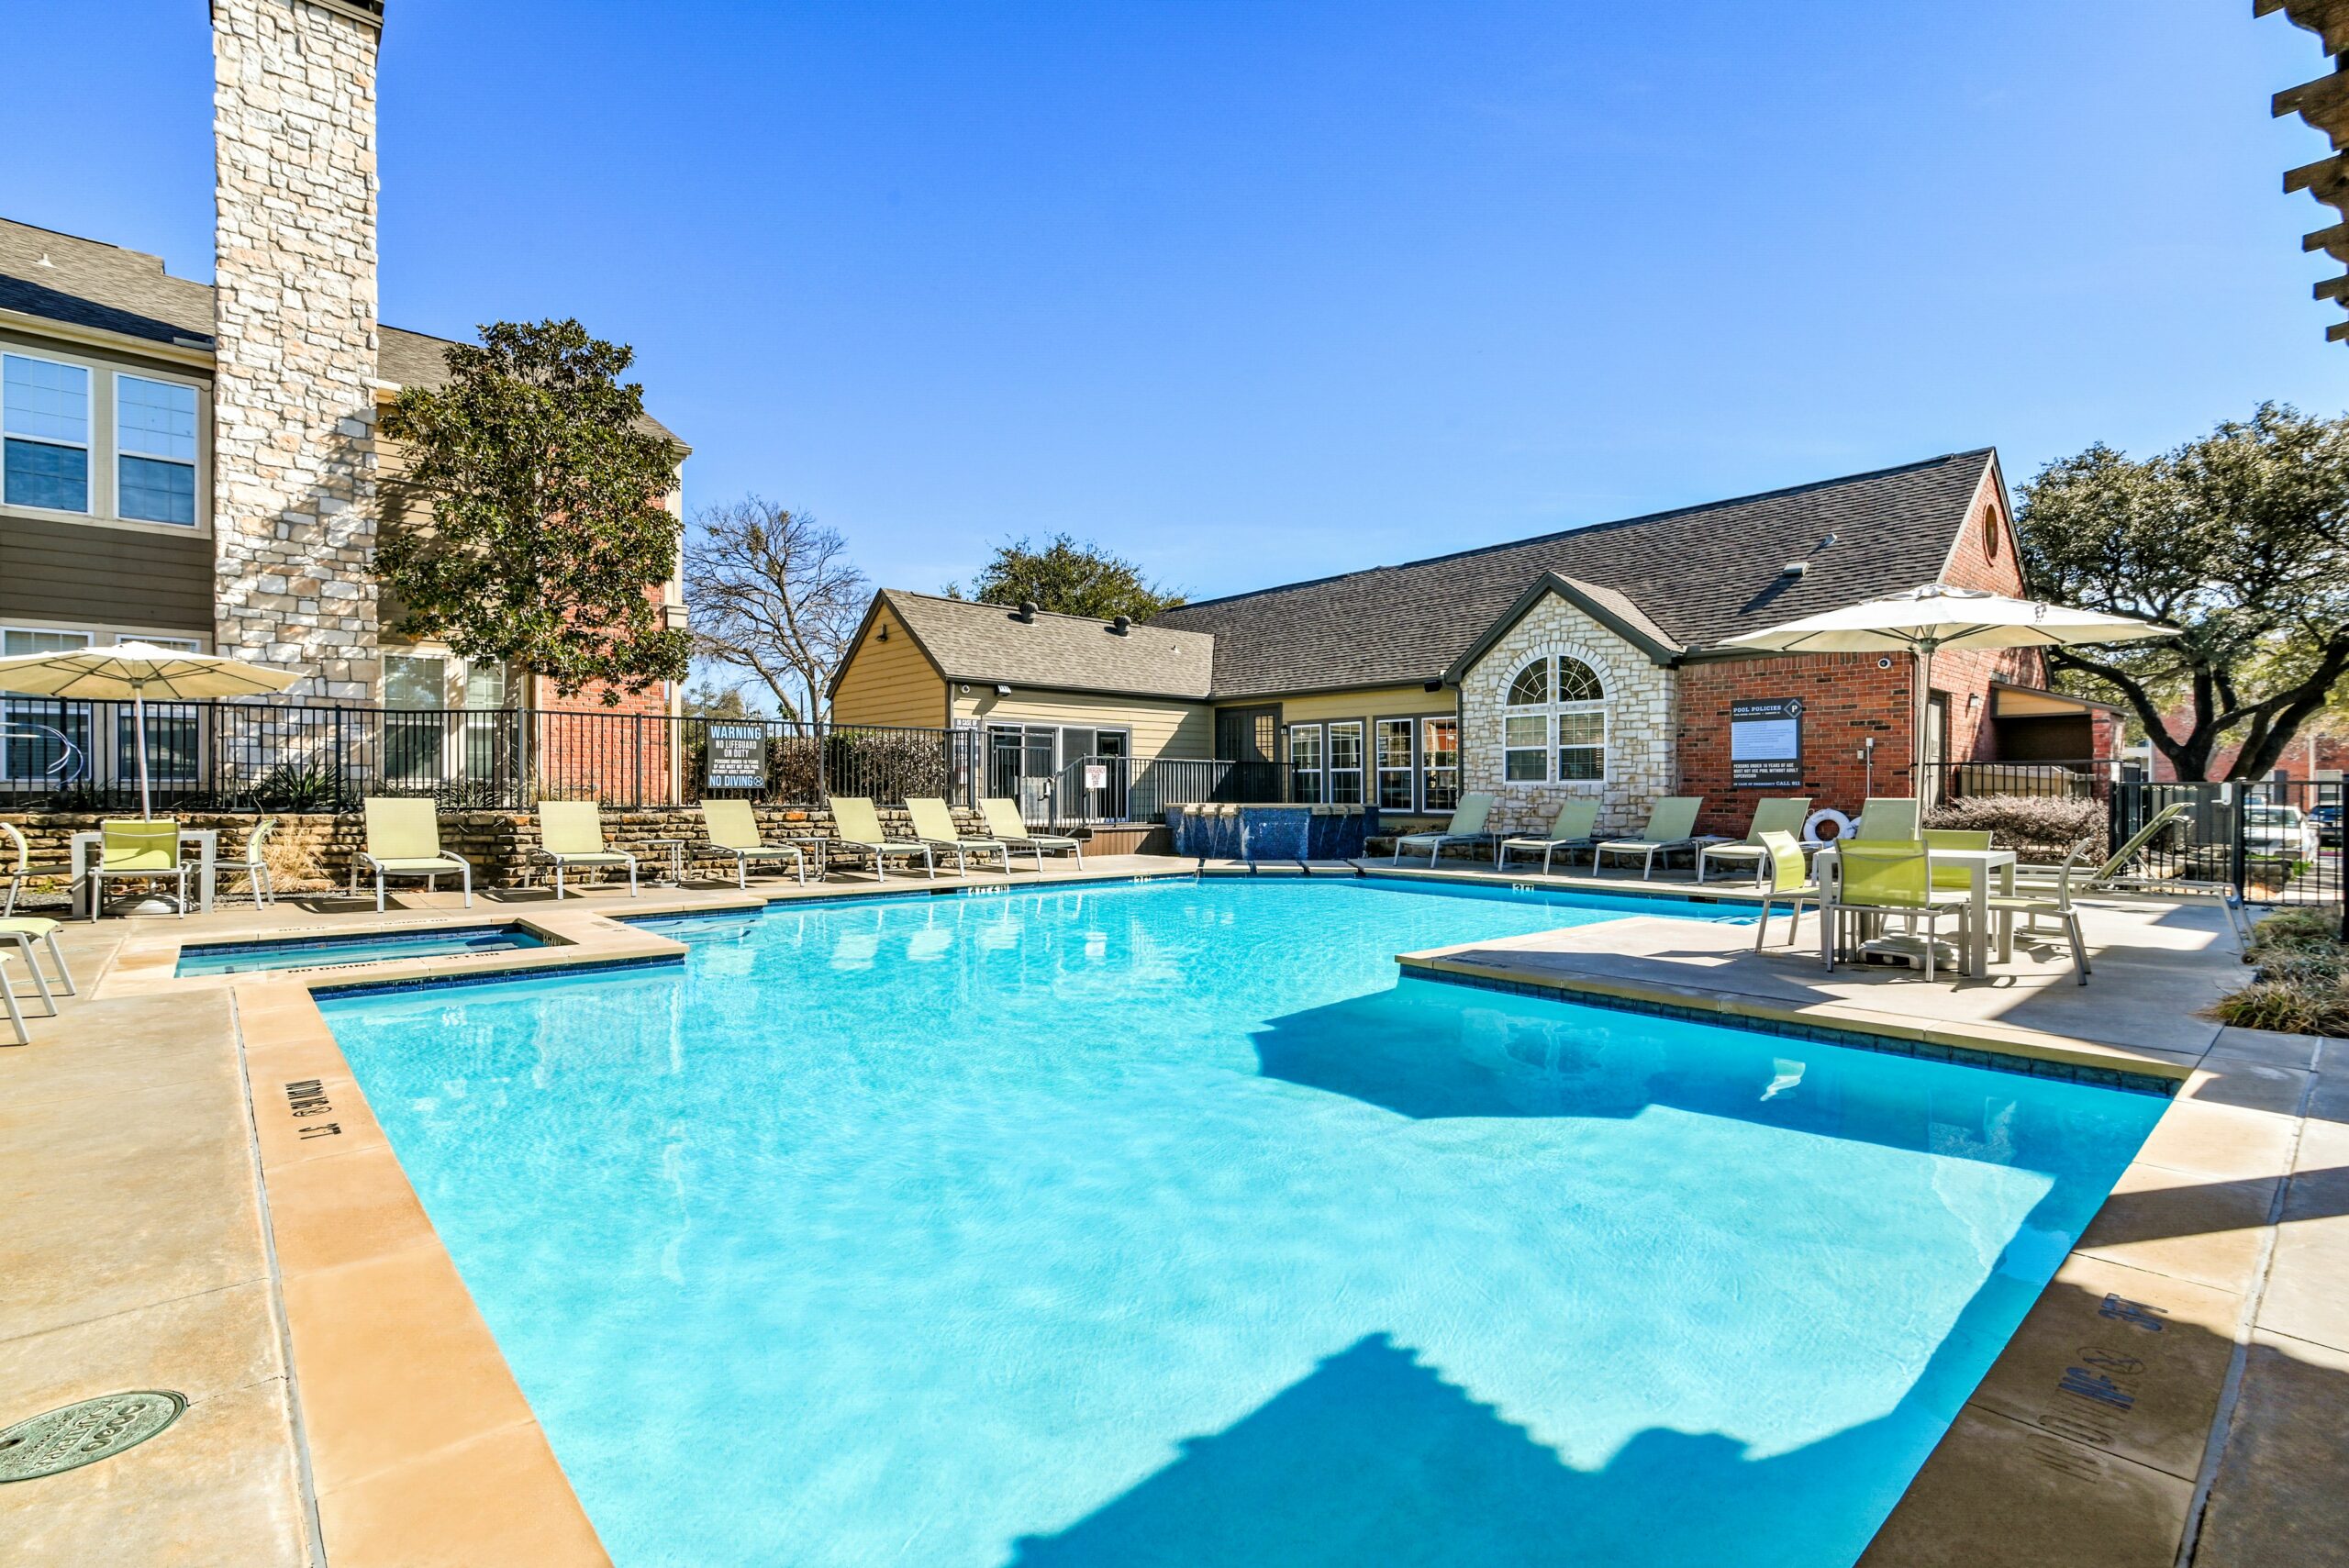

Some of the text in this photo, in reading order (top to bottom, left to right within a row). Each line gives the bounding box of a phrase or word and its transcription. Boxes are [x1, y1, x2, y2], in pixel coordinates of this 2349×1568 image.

[710, 726, 761, 740] WARNING
[716, 740, 757, 749] NO LIFEGUARD
[709, 775, 753, 786] NO DIVING
